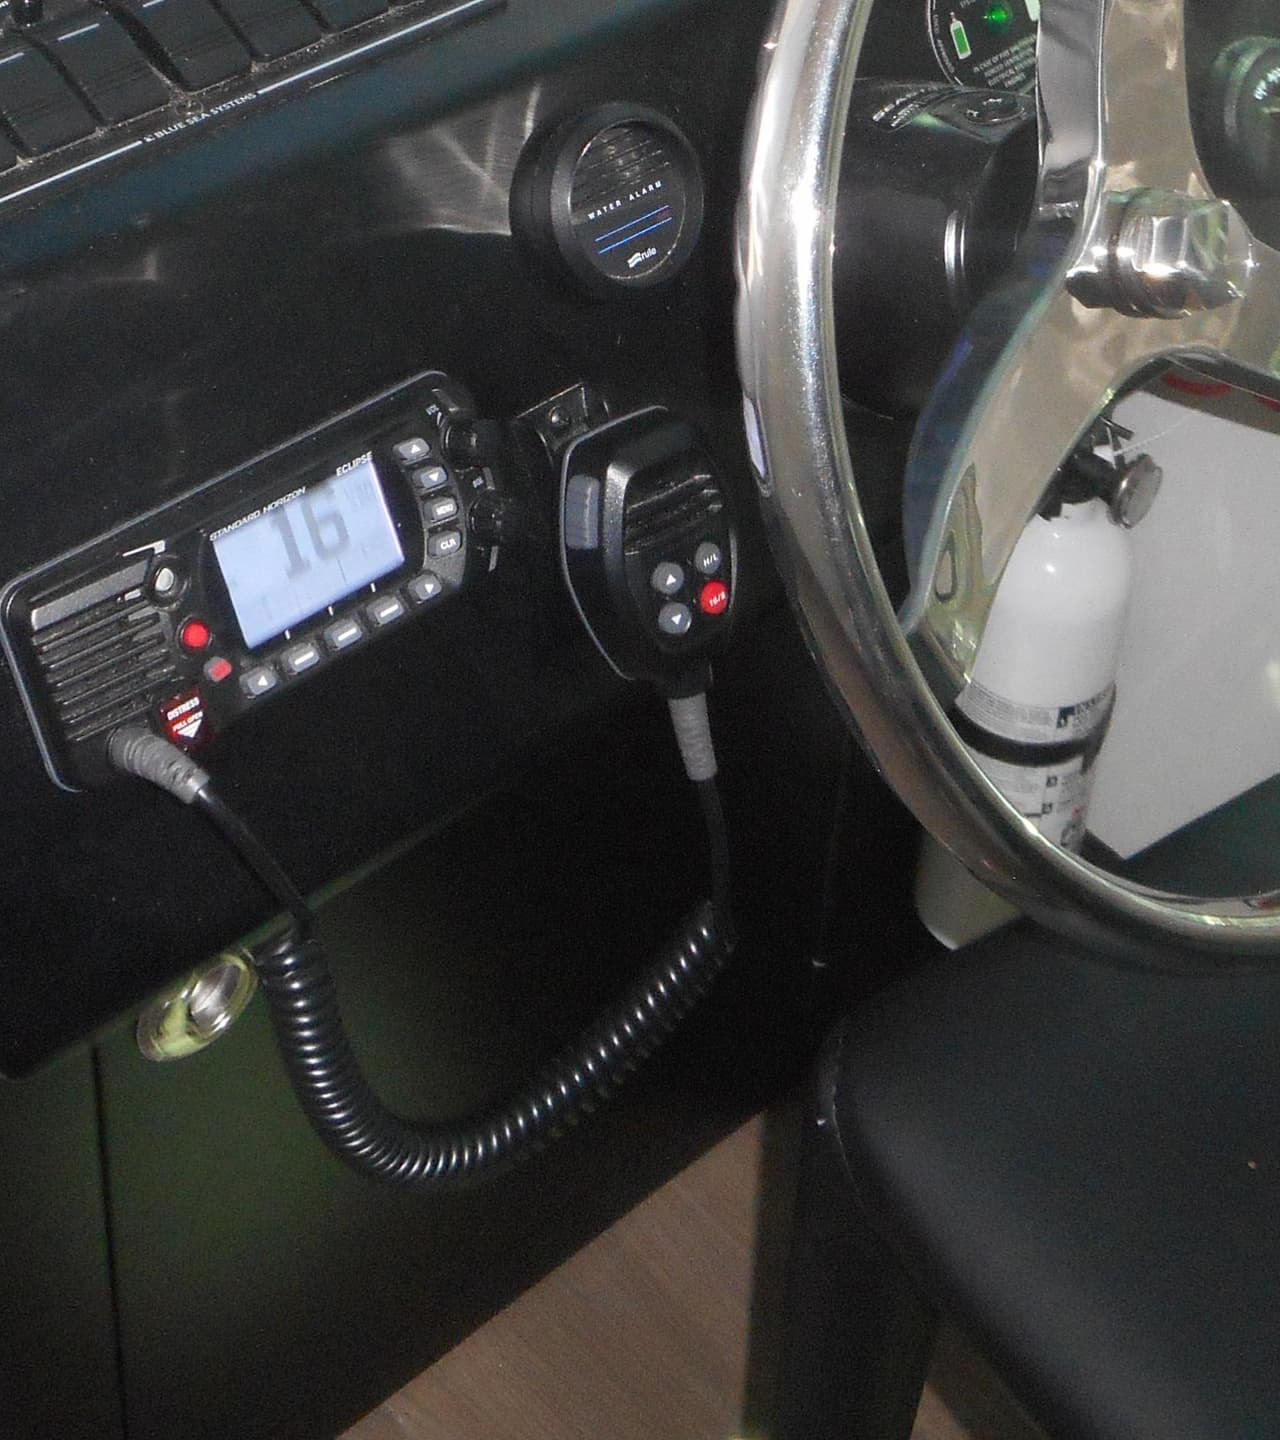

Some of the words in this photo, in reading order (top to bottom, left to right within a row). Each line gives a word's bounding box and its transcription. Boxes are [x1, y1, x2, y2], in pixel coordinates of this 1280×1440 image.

[154, 121, 186, 138] BLUE
[186, 112, 211, 126] SEA
[210, 92, 257, 115] SYSTEMS
[587, 200, 622, 220] WATER
[629, 180, 662, 201] ALARM
[336, 451, 373, 476] ECLIPSE
[209, 509, 261, 542] STANDARD
[262, 486, 307, 514] HORIZON
[271, 483, 351, 578] 16
[167, 696, 200, 721] DISTRESS
